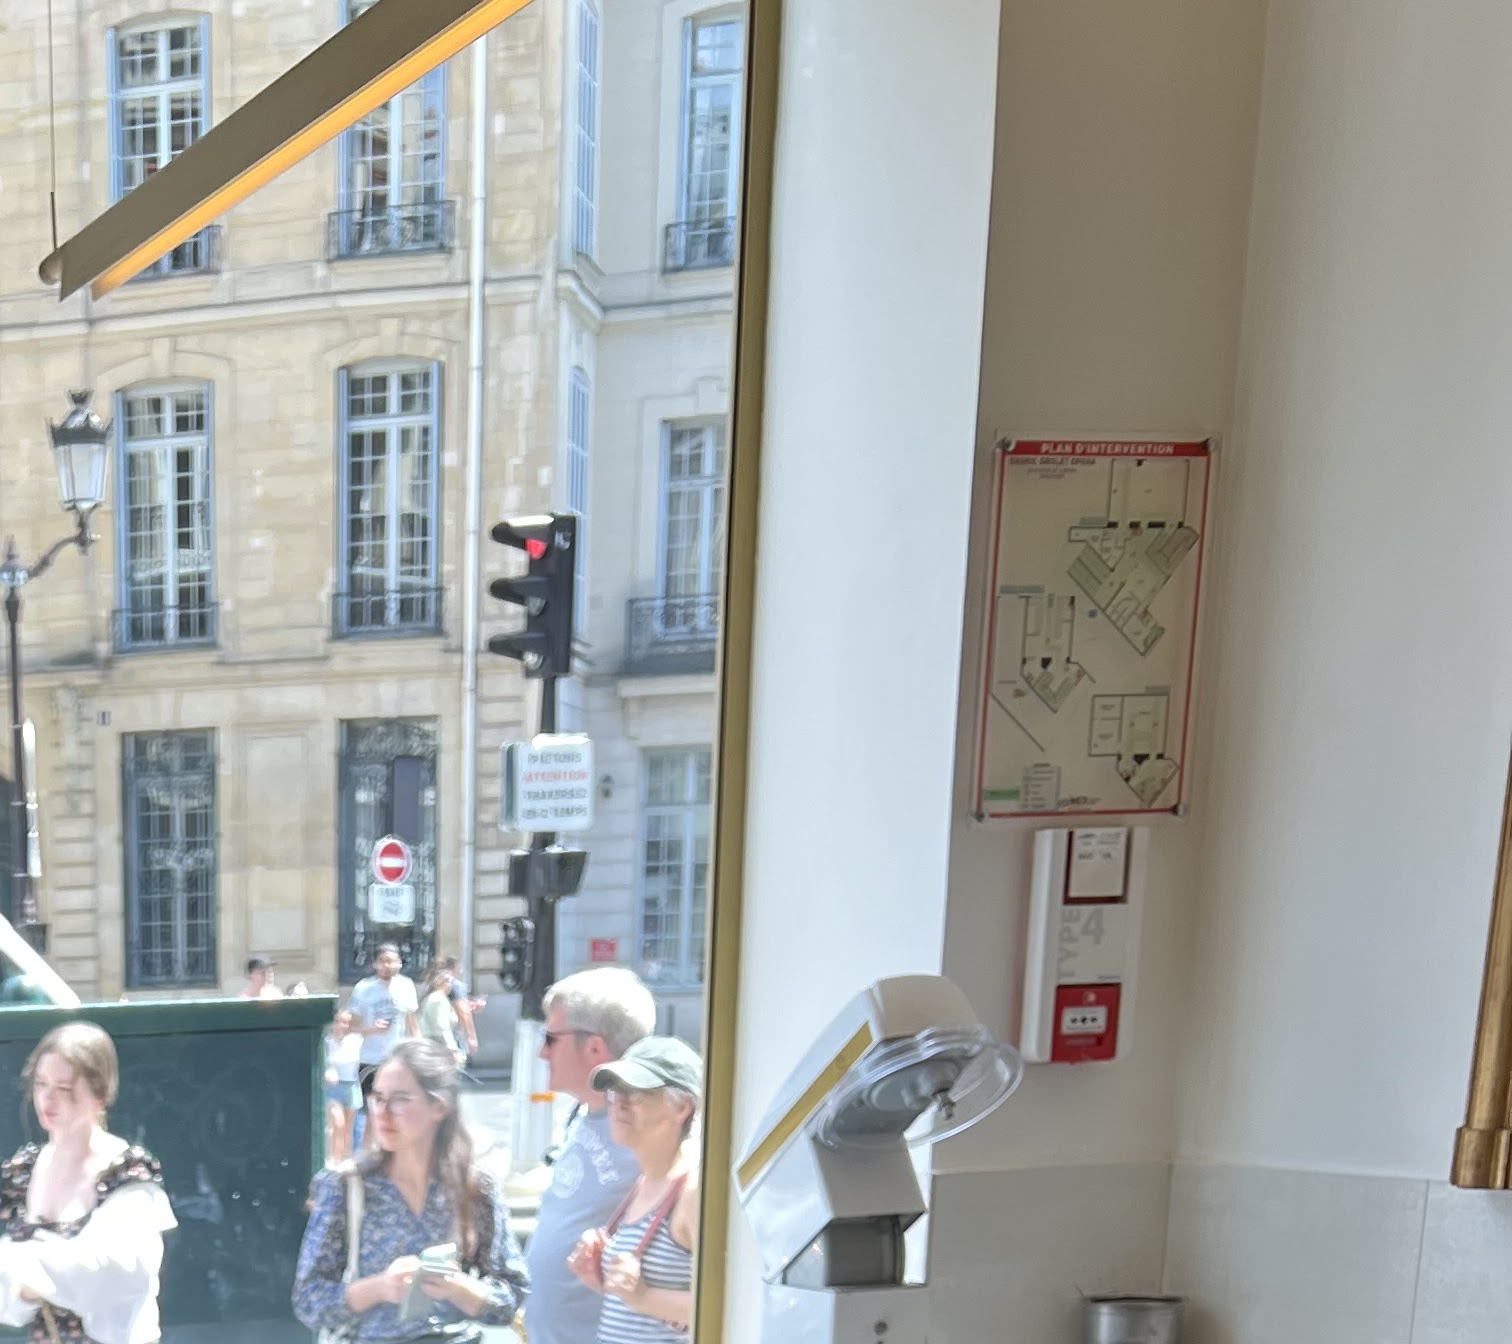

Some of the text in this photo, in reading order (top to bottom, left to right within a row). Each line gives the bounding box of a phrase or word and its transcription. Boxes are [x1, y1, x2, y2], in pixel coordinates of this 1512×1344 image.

[1040, 443, 1175, 455] PLAN D'INTERVENTION
[1058, 907, 1105, 978] TYPE 4
